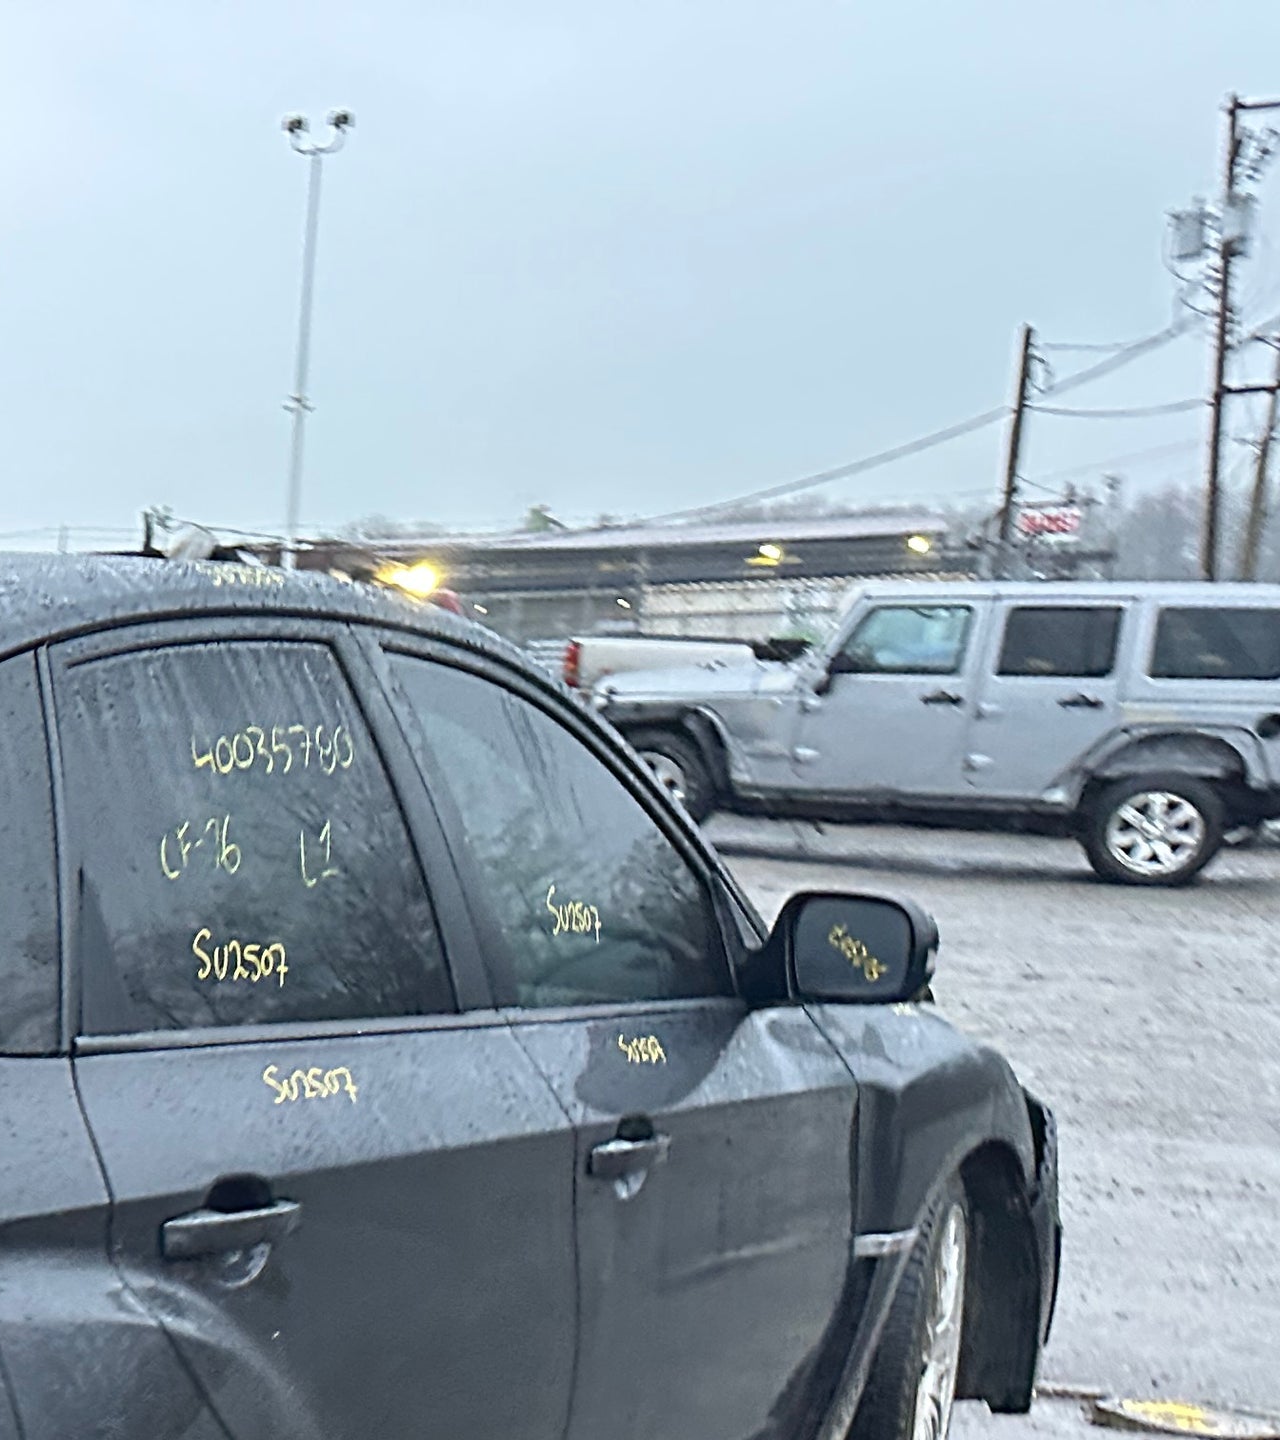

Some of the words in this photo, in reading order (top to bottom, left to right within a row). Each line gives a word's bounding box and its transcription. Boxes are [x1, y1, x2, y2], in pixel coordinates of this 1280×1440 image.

[546, 884, 602, 945] SU2507
[192, 928, 289, 988] SU2507
[262, 1064, 358, 1104] SU2507
